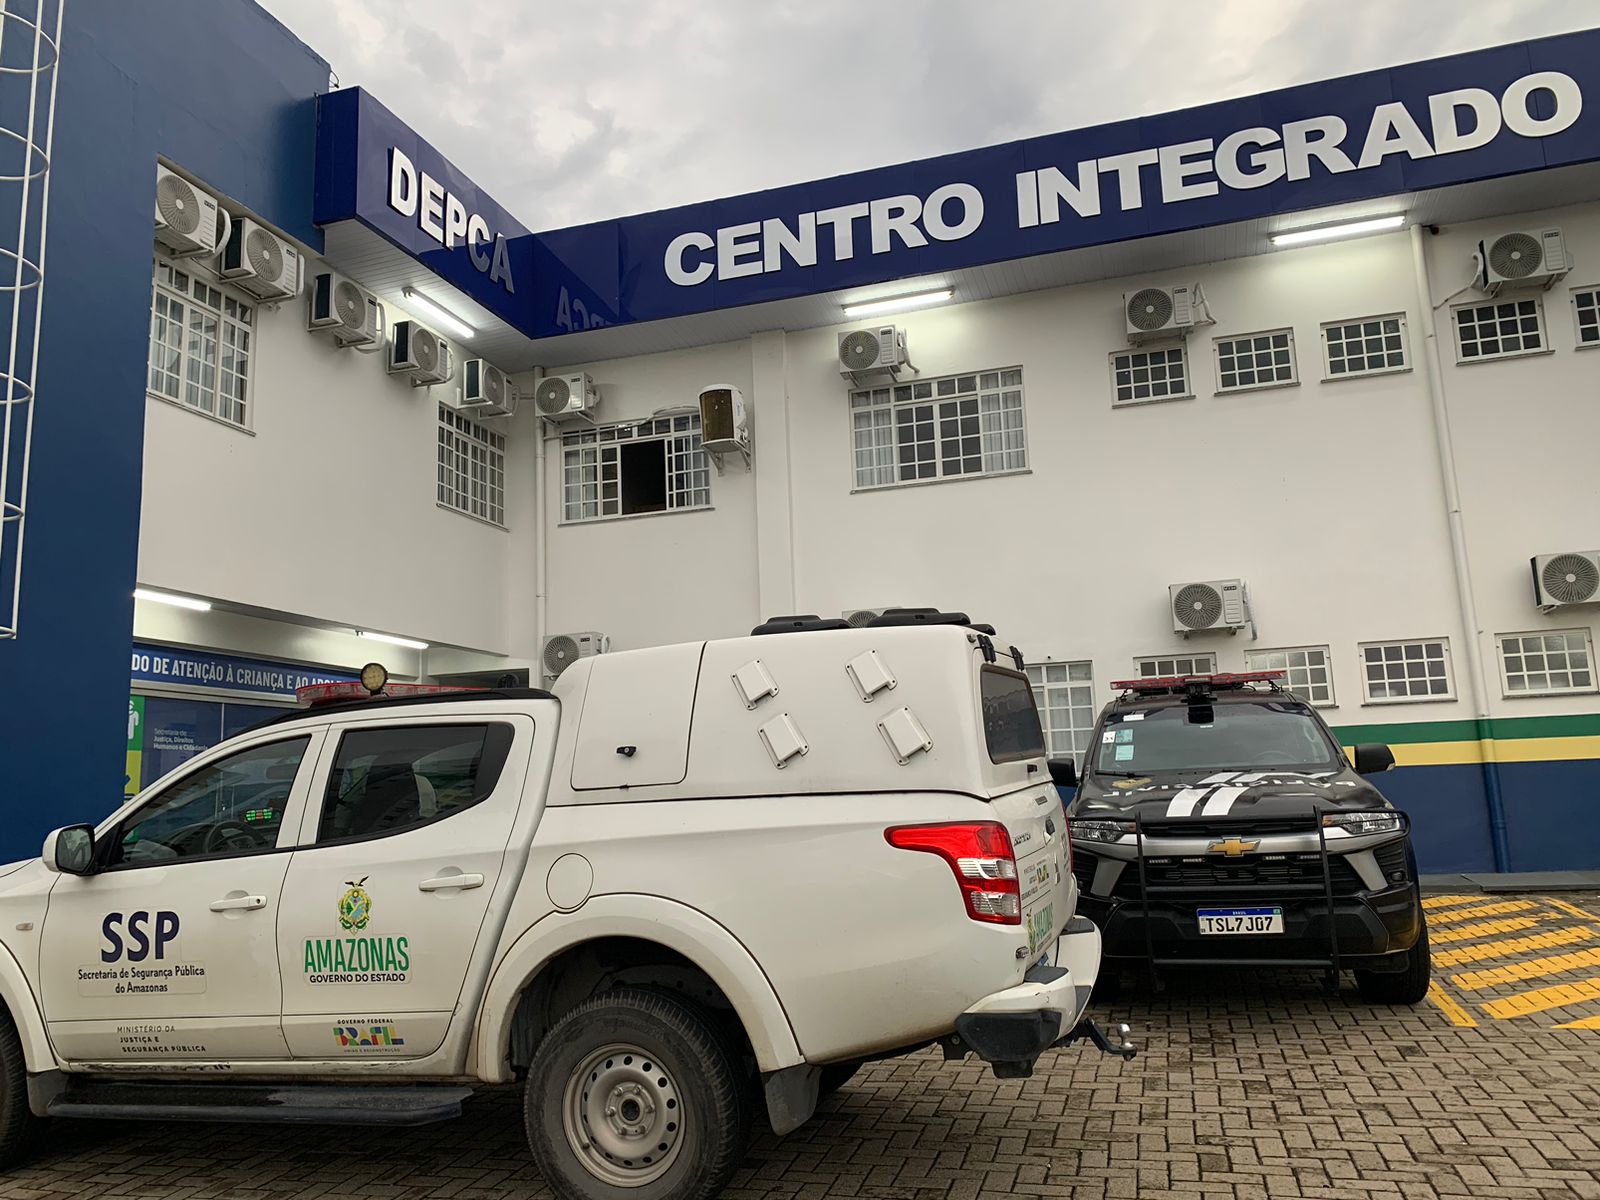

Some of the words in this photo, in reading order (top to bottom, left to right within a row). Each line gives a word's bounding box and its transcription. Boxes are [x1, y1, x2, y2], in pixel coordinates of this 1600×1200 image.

[664, 182, 984, 286] CENTRO
[1016, 71, 1582, 228] INTEGRADO
[389, 145, 515, 294] DEPCA
[152, 657, 169, 675] DE
[171, 660, 223, 683] ATENÇÃO
[226, 664, 234, 682] À
[236, 668, 284, 691] CRIANÇA
[286, 675, 293, 690] E
[101, 911, 180, 963] SSP
[304, 937, 410, 973] AMAZONAS
[78, 968, 118, 980] Secretaria
[119, 967, 129, 979] de
[131, 967, 173, 981] Segurança
[175, 965, 205, 976] Pública
[310, 974, 353, 983] GOVERNO
[355, 974, 368, 982] DO
[371, 973, 405, 982] ESTADO
[115, 983, 125, 994] do
[127, 981, 168, 993] Amazonas
[117, 1025, 162, 1033] MINISTÉRIO
[333, 1025, 404, 1046] BRASIL
[120, 1036, 152, 1044] JUSTIÇA
